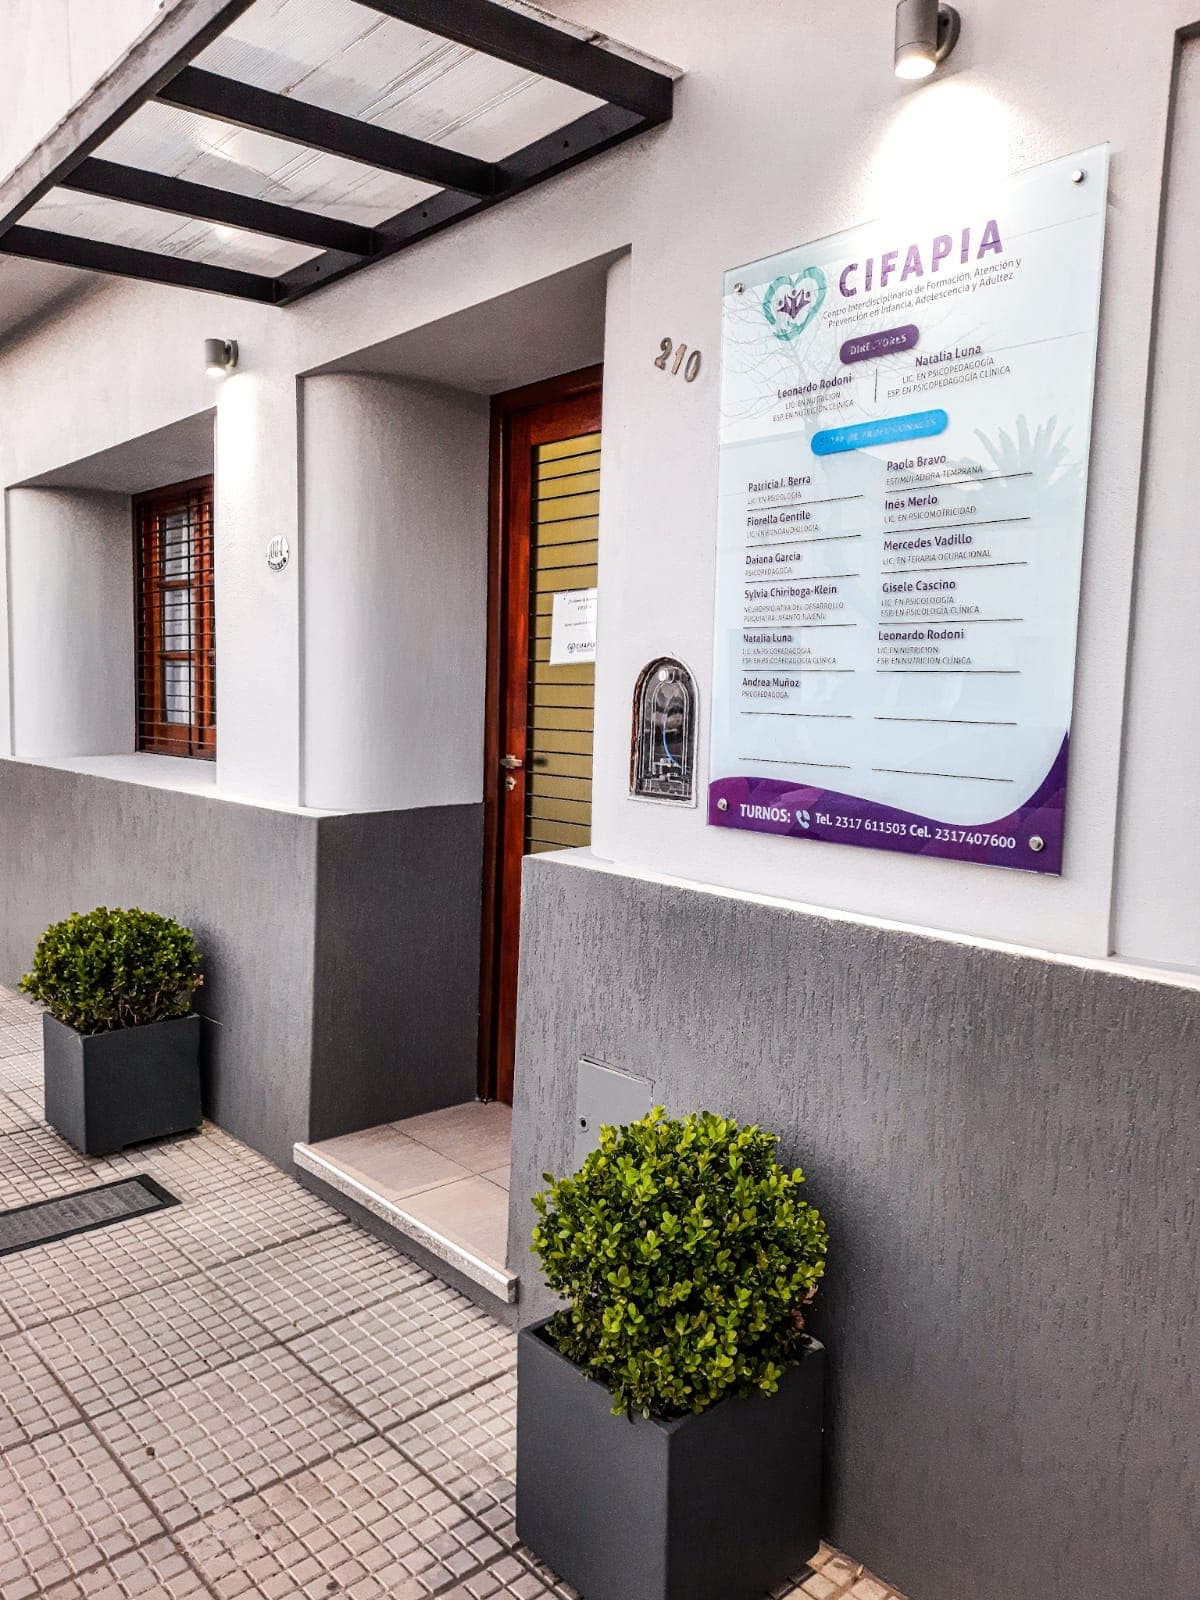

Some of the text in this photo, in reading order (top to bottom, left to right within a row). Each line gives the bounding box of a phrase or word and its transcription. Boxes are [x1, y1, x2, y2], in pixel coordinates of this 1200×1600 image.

[839, 219, 1003, 297] CIFAPIA
[823, 258, 1021, 320] Centro Interdisciplinario de Formación, Atención y
[828, 272, 1014, 329] Prevención en Infancia, Adolescencia y Adultez
[654, 336, 702, 383] 210
[915, 345, 982, 367] Natalia Luna
[887, 389, 900, 398] ESP.
[902, 386, 912, 395] EN
[979, 365, 1011, 379] CLÍNICA
[916, 372, 926, 381] EN
[777, 373, 852, 399] Leonardo Rodoni
[785, 412, 793, 420] EN
[887, 454, 946, 472] Paola Bravo
[748, 479, 779, 492] Patricia
[788, 475, 811, 486] Berra
[886, 465, 984, 486] ESTIMULADORA TEMPRANA
[885, 494, 938, 510] Inés Merlo
[747, 510, 811, 527] Fiorella Gentile
[898, 513, 908, 522] EN
[908, 505, 977, 520] PSICOMOTRICIDAD
[883, 533, 972, 551] Mercedes Vadillo
[745, 554, 773, 565] Daiana
[896, 555, 906, 564] EN
[908, 553, 936, 563] TERAPIA
[937, 549, 992, 561] OCUPACIONAL
[744, 585, 837, 601] Sylvia Chiriboga-Klein
[882, 579, 956, 593] Gisele Cascino
[894, 598, 904, 606] EN
[743, 633, 792, 643] Natalia Luna
[878, 628, 964, 641] Leonardo Rodoni
[889, 646, 898, 654] EN
[891, 657, 900, 665] EN
[742, 678, 800, 688] Andrea Muñoz
[740, 804, 1016, 849] TURNOS: Tel. 2317 611503 Cel. 2317407600
